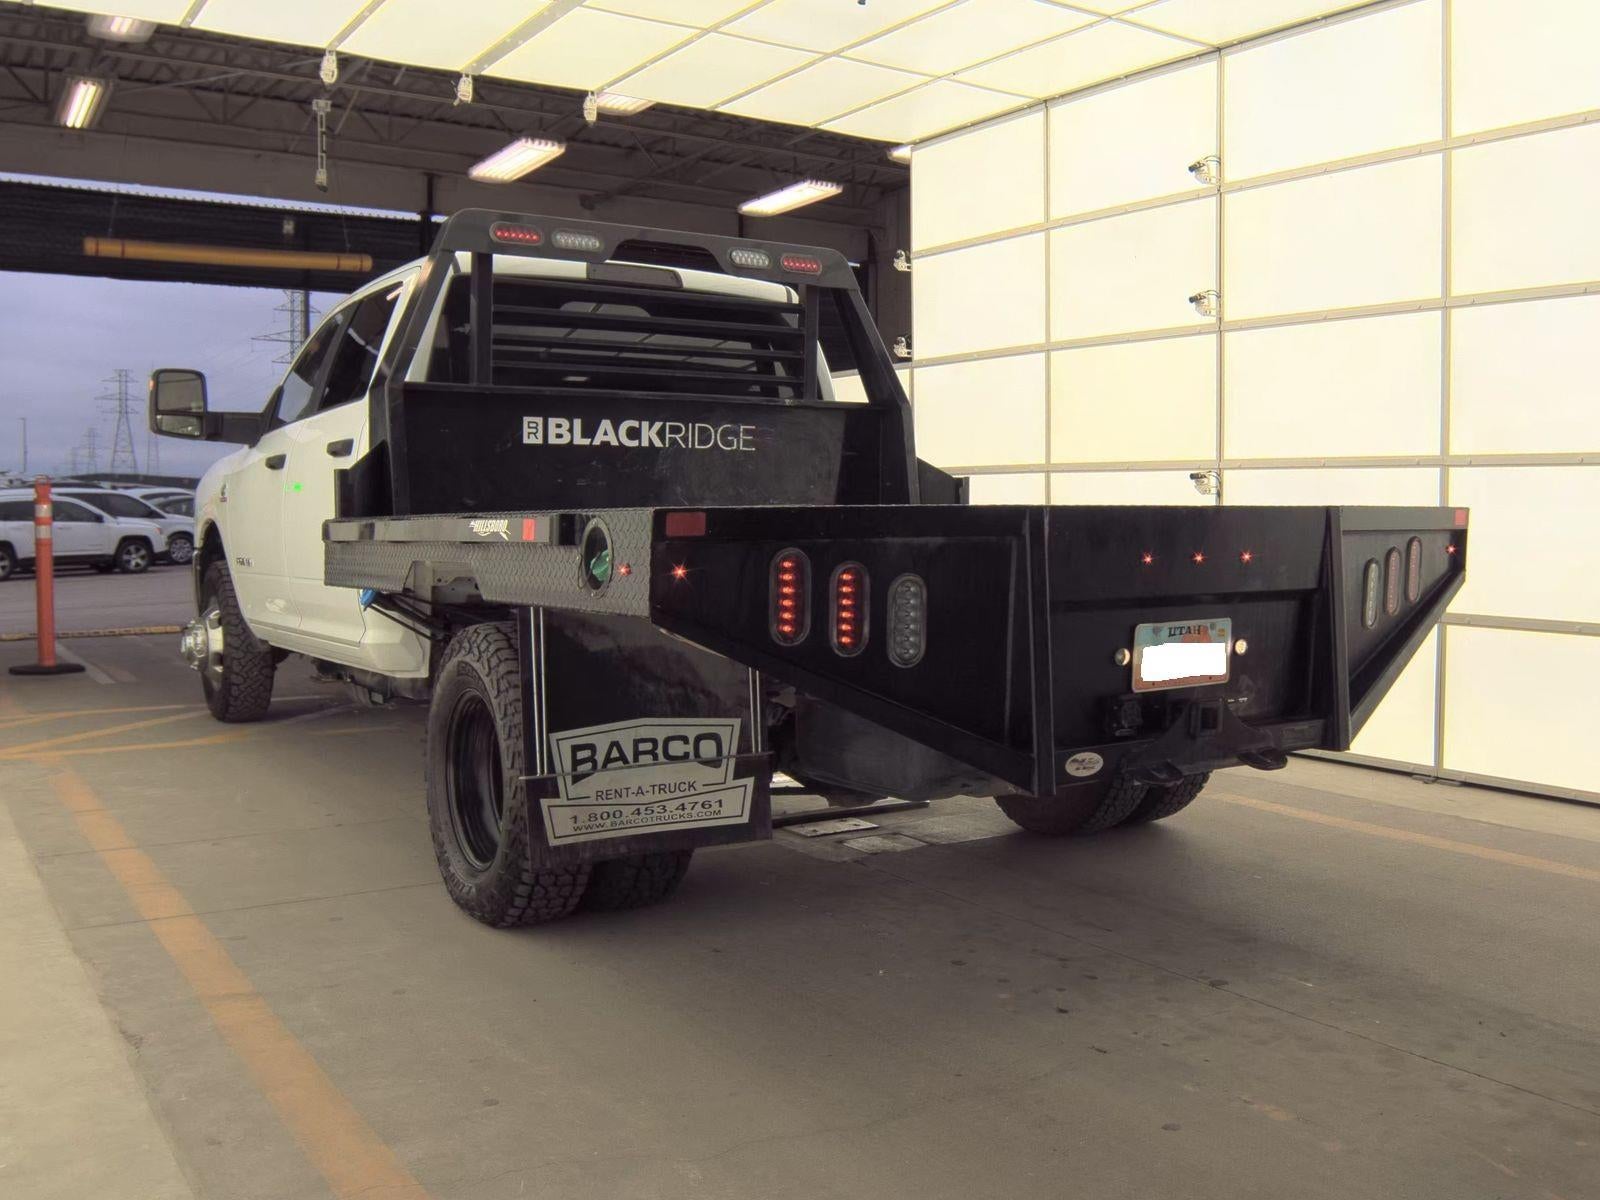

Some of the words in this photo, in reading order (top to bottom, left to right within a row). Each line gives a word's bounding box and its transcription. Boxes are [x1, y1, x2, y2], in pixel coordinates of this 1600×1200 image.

[548, 418, 756, 451] BLACKRIDGE
[1168, 625, 1201, 637] UTAH
[571, 732, 723, 786] BARCO
[595, 781, 697, 801] RENT-A-TRUCK
[569, 799, 724, 824] 1.800.453.4761
